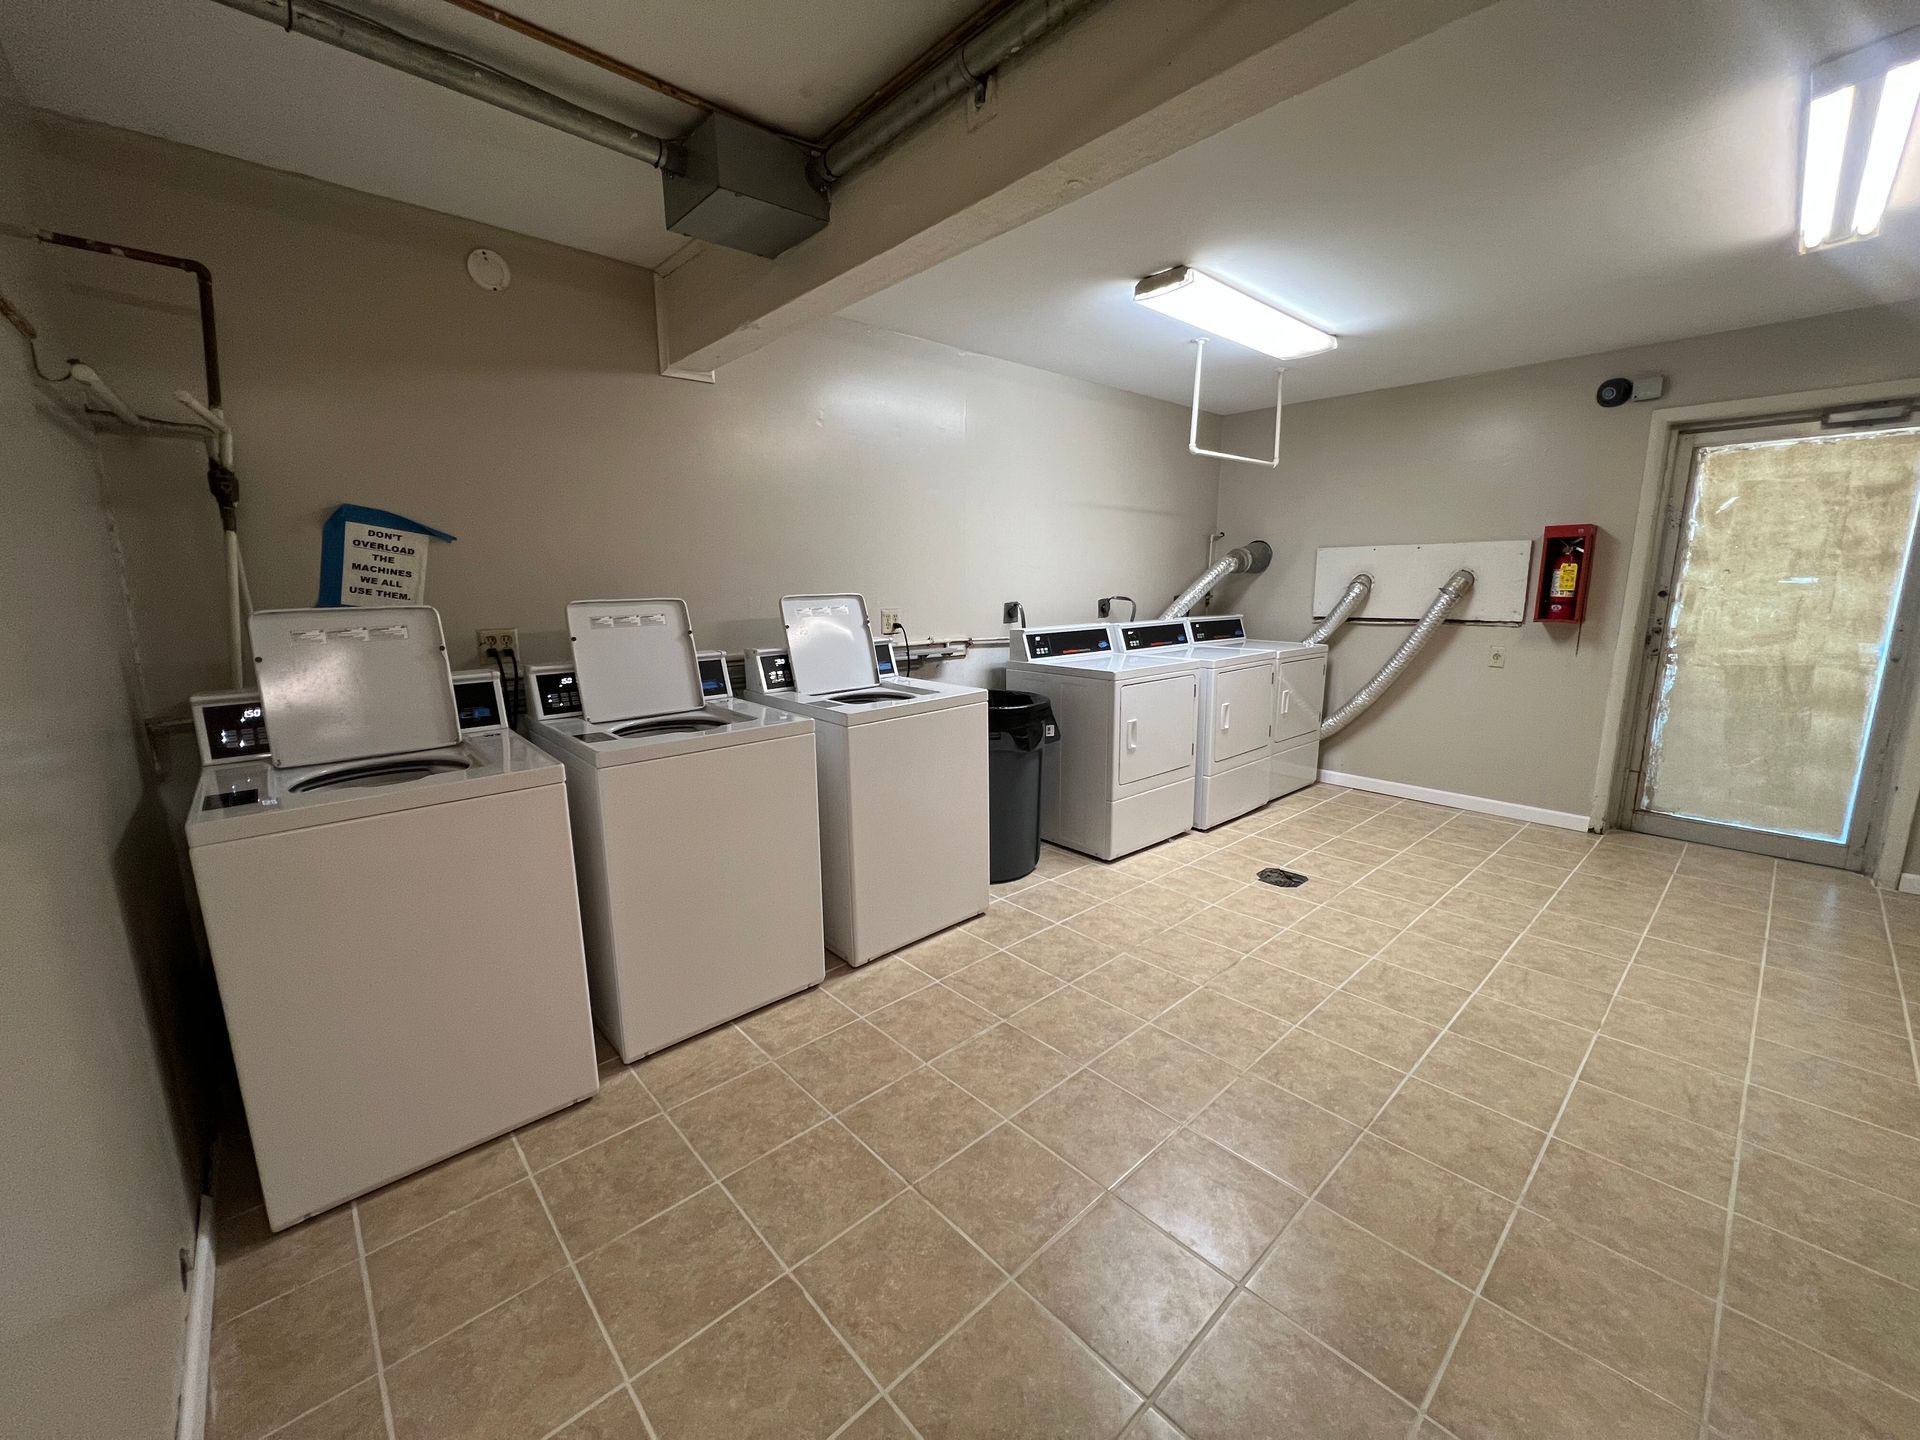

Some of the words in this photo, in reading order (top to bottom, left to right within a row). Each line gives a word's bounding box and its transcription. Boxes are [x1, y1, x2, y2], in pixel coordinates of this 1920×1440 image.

[368, 530, 402, 541] DON'T
[352, 539, 415, 555] OVERLOAD
[372, 554, 395, 564] THE
[352, 563, 412, 578] MACHINES
[360, 575, 378, 585] WE
[381, 579, 403, 588] ALL
[349, 586, 373, 596] USE
[376, 590, 411, 601] THEM.
